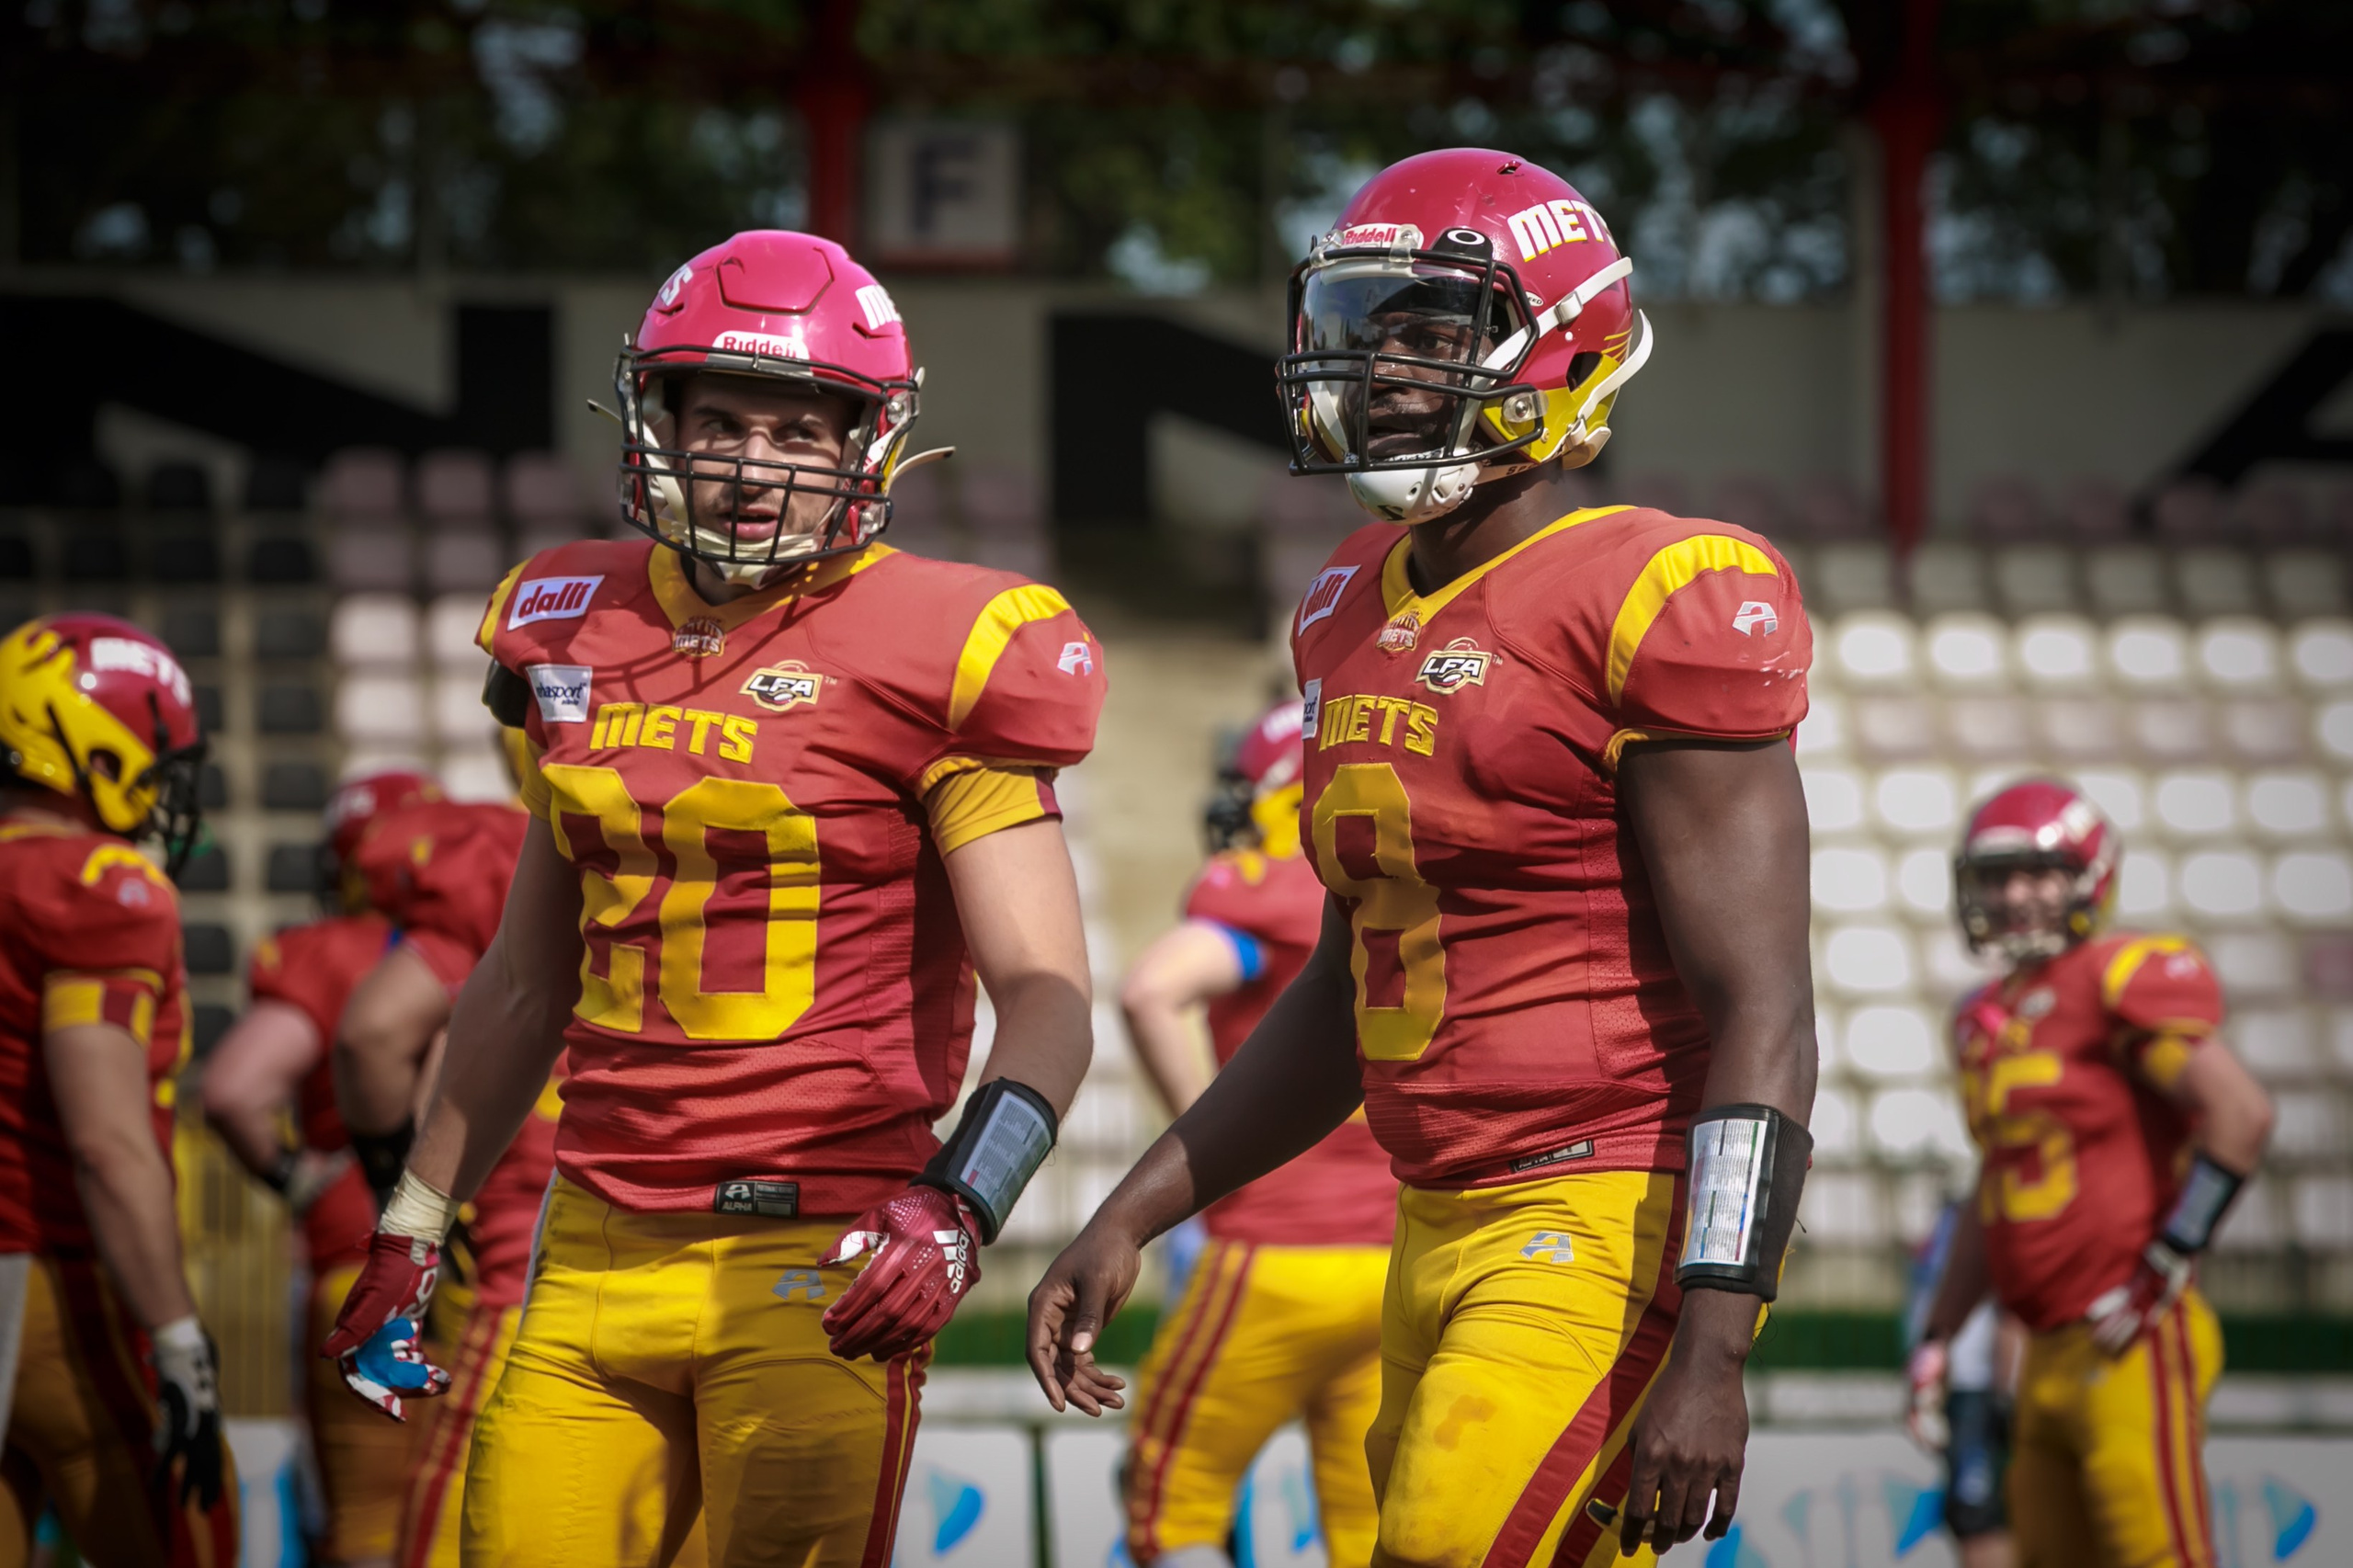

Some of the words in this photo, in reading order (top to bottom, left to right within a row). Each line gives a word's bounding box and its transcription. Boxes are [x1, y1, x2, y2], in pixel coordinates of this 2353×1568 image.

[1507, 199, 1620, 262] MET
[518, 582, 591, 618] dalli
[749, 676, 814, 696] LFA
[1424, 657, 1483, 676] LFA
[589, 702, 759, 764] METS
[1318, 694, 1439, 756] METS
[541, 763, 821, 1040] 20
[1313, 762, 1449, 1062] 8
